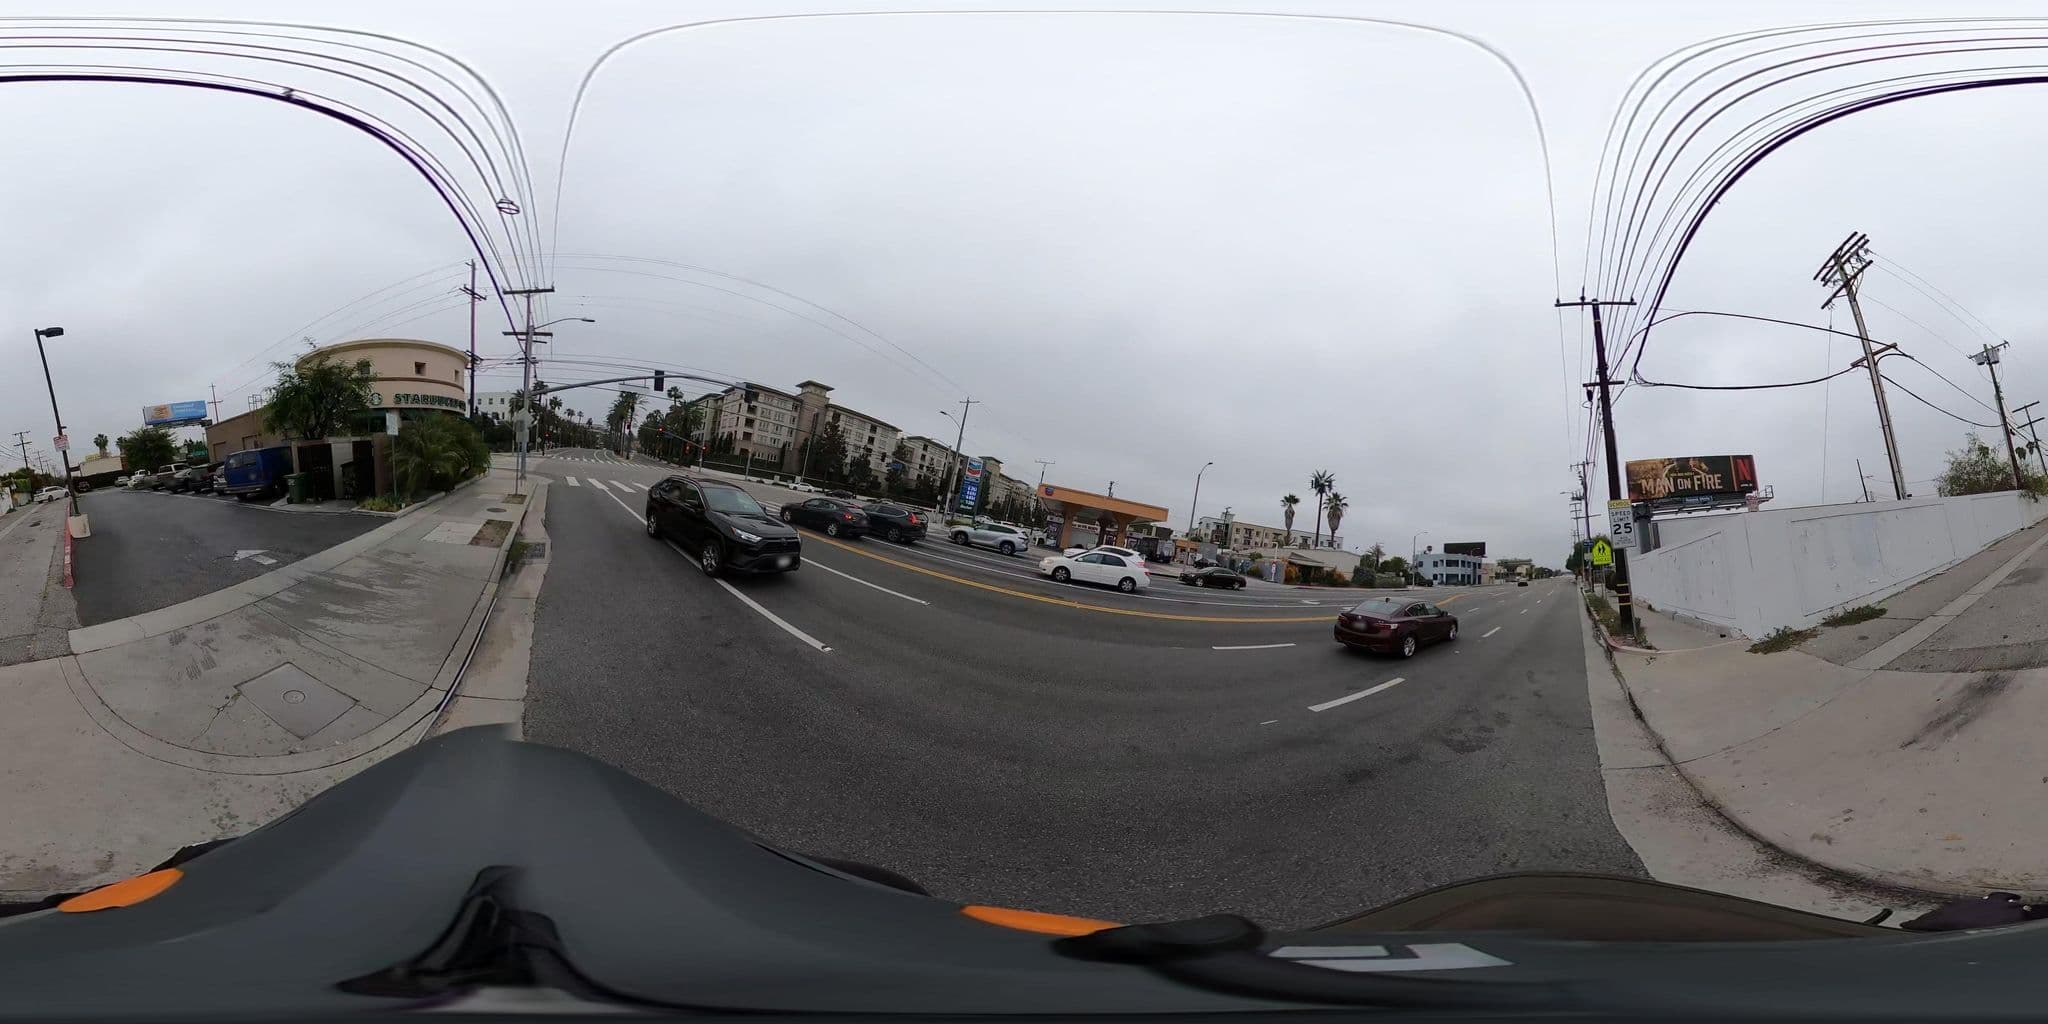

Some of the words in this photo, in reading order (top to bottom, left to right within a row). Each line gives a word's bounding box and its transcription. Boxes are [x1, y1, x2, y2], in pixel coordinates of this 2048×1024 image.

[1641, 477, 1675, 494] MAN
[1677, 477, 1692, 490] ON
[1694, 473, 1723, 491] FIRE
[1613, 522, 1633, 535] 25
